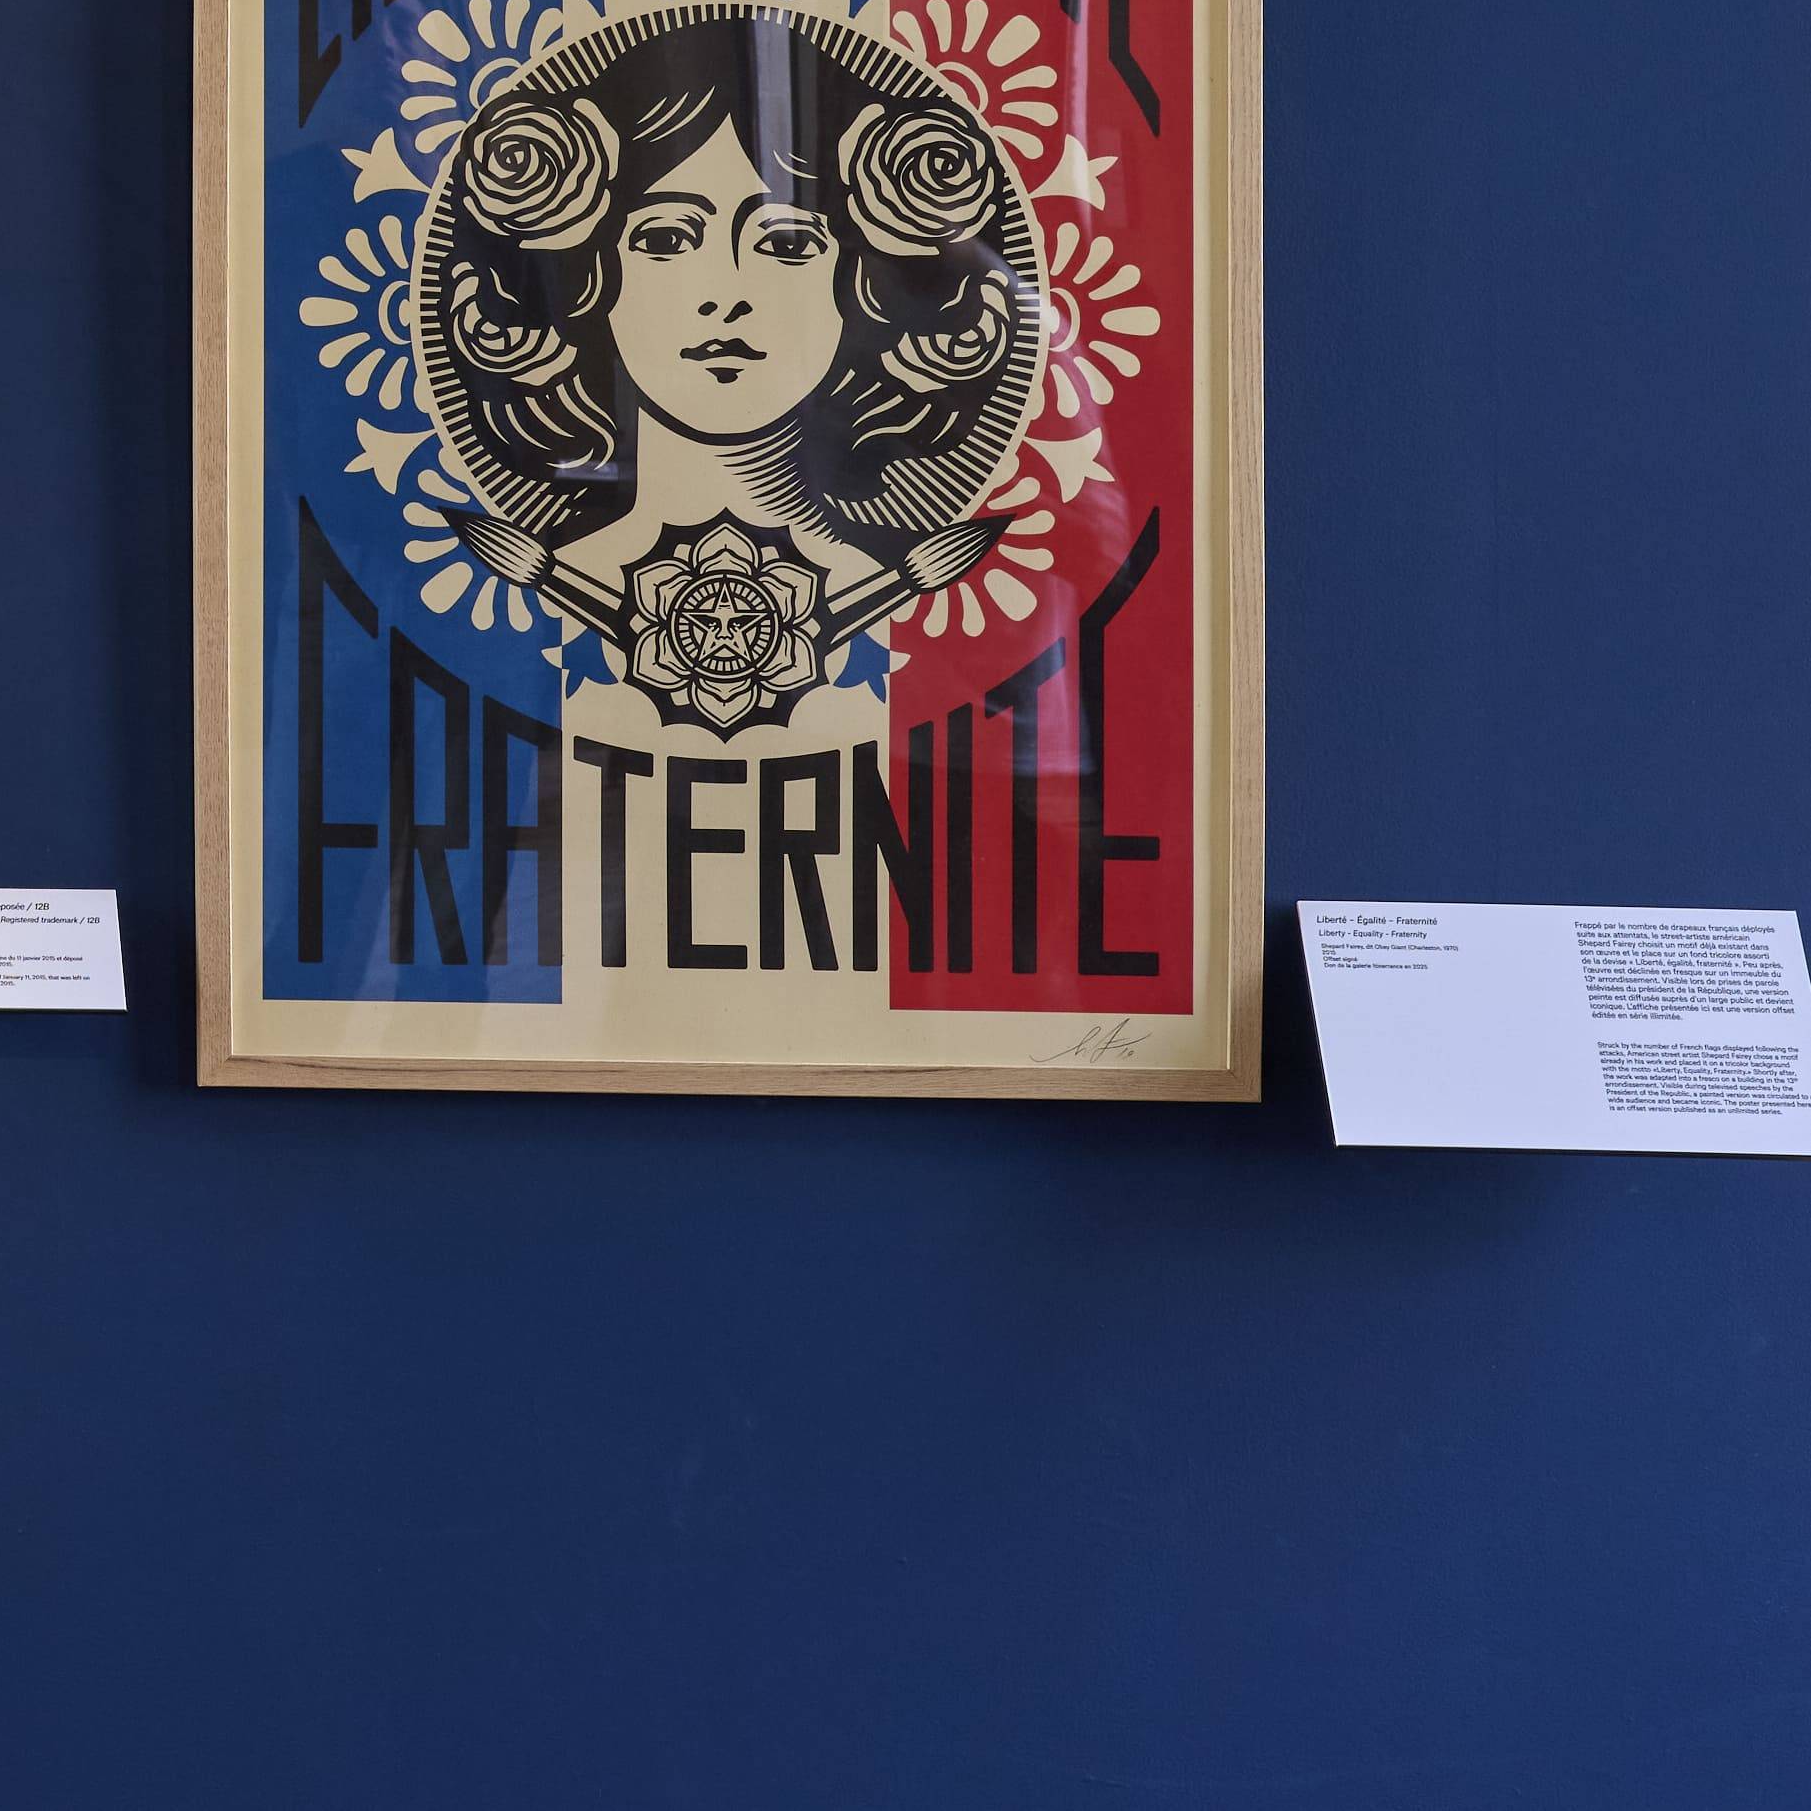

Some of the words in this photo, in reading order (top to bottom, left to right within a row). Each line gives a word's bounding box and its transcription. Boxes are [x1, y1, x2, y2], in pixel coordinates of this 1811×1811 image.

[298, 495, 1161, 977] FRATERNITE
[0, 916, 39, 925] Registered
[1316, 915, 1347, 924] Liberté
[1357, 915, 1387, 925] Égalité
[1396, 916, 1438, 926] Fraternité
[1627, 922, 1658, 930] nombre
[1659, 923, 1670, 931] de
[1670, 923, 1706, 933] drapeaux
[1319, 929, 1346, 938] Liberty
[1353, 930, 1384, 939] Equality
[1391, 930, 1427, 939] Fraternity
